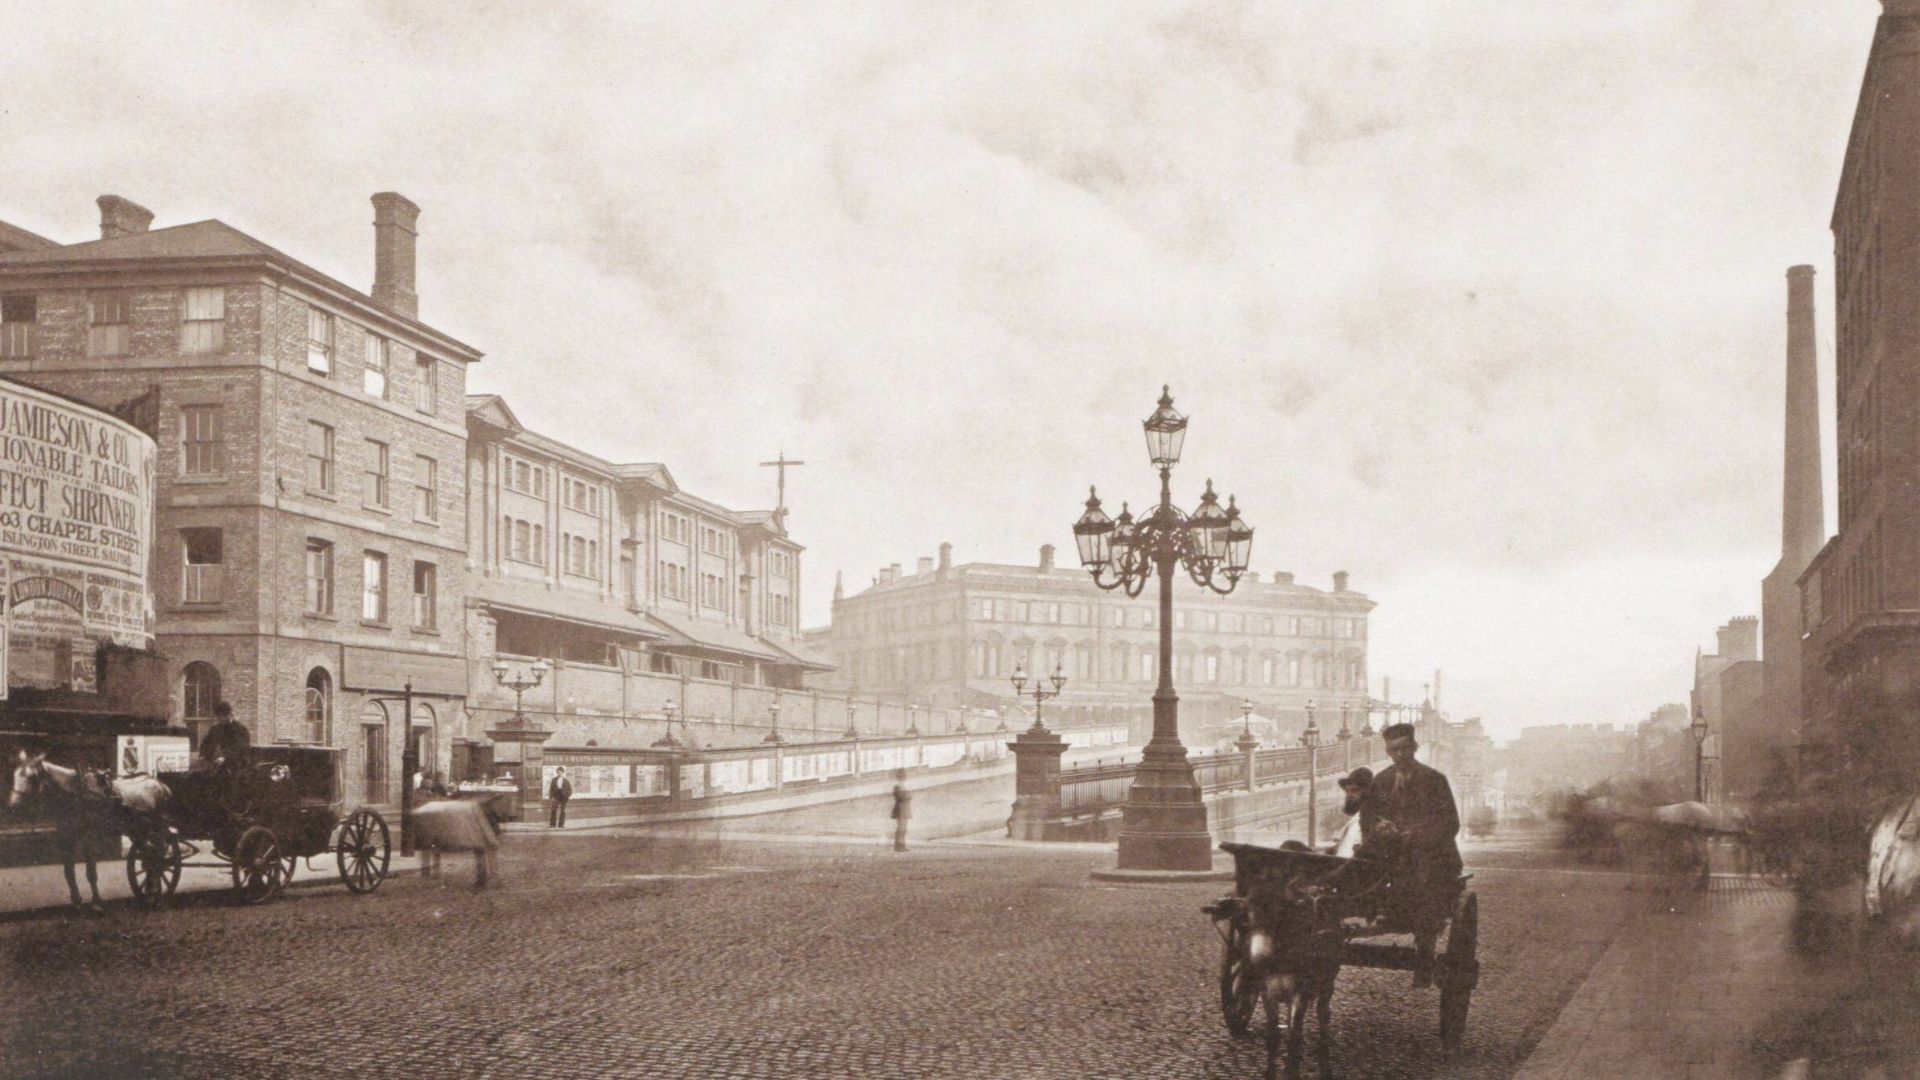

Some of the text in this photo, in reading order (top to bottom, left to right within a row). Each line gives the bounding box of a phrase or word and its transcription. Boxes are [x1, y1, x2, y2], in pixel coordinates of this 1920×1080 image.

[0, 396, 92, 456] JAMIESON
[97, 426, 110, 460] &
[91, 459, 139, 499] TAILORS
[0, 468, 137, 535] FECT SHRINKER
[2, 529, 57, 551] ISLINGTON
[27, 513, 97, 544] CHAPEL
[99, 529, 140, 556] STREET
[12, 578, 46, 603] LONDON
[48, 579, 82, 611] JOURNAL
